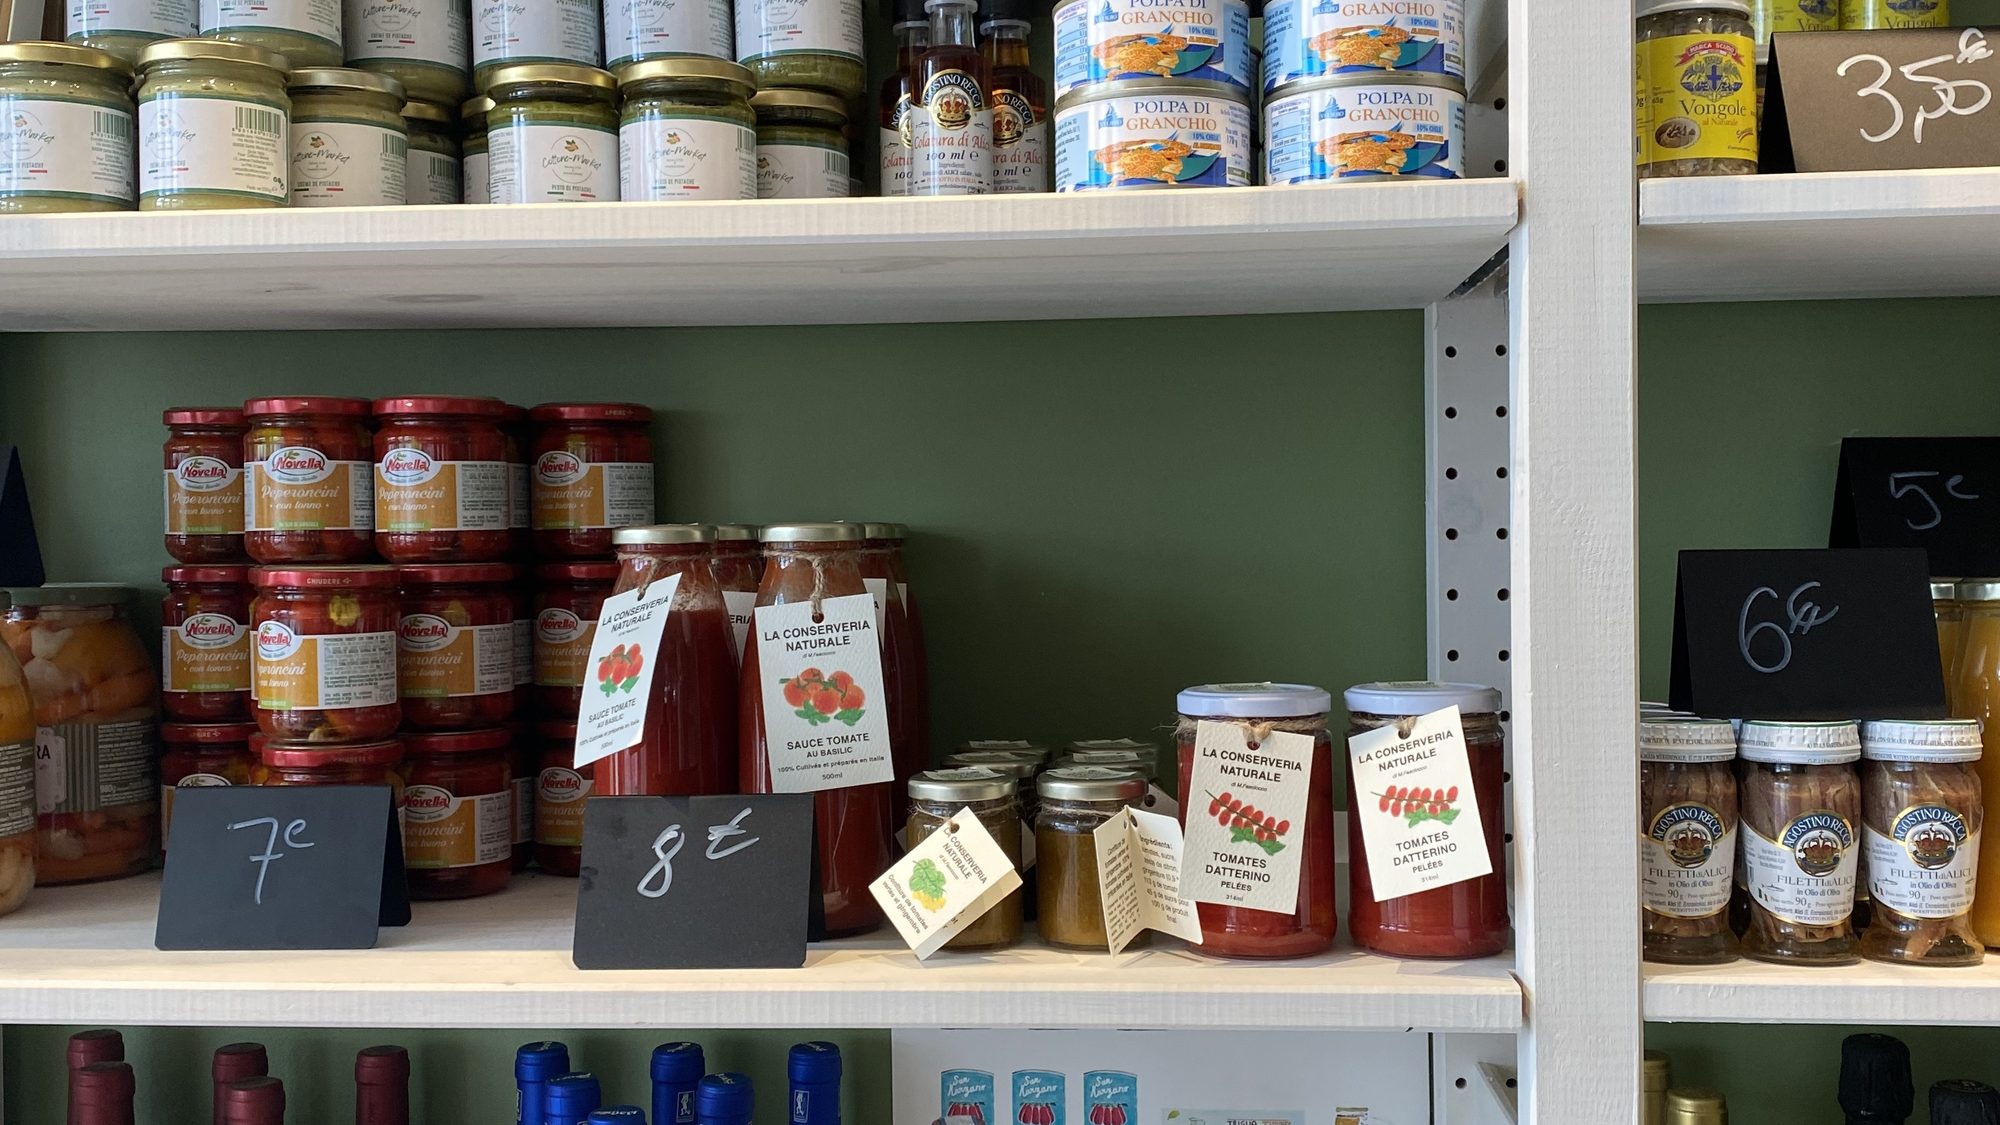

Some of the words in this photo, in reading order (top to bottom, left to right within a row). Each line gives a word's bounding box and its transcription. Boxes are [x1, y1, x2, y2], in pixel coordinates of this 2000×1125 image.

[1342, 2, 1435, 17] GRANCHIO
[1121, 10, 1213, 25] GRANCHIO
[923, 74, 960, 105] AGOSTINO
[960, 78, 981, 108] RECCA
[1358, 92, 1414, 105] POLPA
[1418, 93, 1433, 106] DI
[1010, 97, 1033, 124] RECCA
[1135, 101, 1190, 114] POLPA
[1194, 102, 1210, 114] DI
[1349, 108, 1440, 122] GRANCHIO
[1680, 99, 1747, 120] Vongole
[1126, 116, 1217, 131] GRANCHIO
[959, 131, 969, 147] di
[950, 150, 966, 160] ml
[272, 457, 325, 471] Novella
[384, 458, 430, 473] Novella
[539, 461, 579, 475] Novella
[180, 466, 227, 479] Novella
[261, 484, 340, 499] Peperoncini
[378, 487, 447, 502] Peperoncini
[294, 500, 323, 509] tonno
[601, 615, 612, 626] LA
[613, 595, 669, 622] CONSERVERIA
[539, 616, 578, 631] Novella
[610, 611, 653, 633] NATURALE
[186, 623, 235, 637] Novella
[400, 625, 448, 639] Novella
[763, 630, 780, 642] LA
[782, 620, 871, 639] CONSERVERIA
[259, 632, 291, 646] Novella
[785, 635, 851, 652] NATURALE
[176, 649, 249, 664] Peperoncini
[588, 708, 610, 723] SAUCE
[610, 698, 637, 714] TOMATE
[786, 738, 824, 750] SAUCE
[826, 733, 870, 746] TOMATE
[1358, 754, 1373, 765] LA
[1374, 729, 1454, 760] CONSERVERIA
[806, 750, 819, 758] AU
[820, 746, 853, 757] BASILIC
[1202, 748, 1218, 759] LA
[1220, 750, 1302, 772] CONSERVERIA
[1378, 748, 1438, 773] NATURALE
[1220, 765, 1282, 783] NATURALE
[542, 777, 580, 789] Novella
[401, 795, 450, 809] Novella
[1653, 808, 1698, 838] AGOSTINO
[1698, 810, 1723, 840] RECCA
[1894, 808, 1941, 840] AGOSTINO
[1942, 811, 1967, 841] RECCA
[1783, 815, 1830, 848] AGOSTINO
[1831, 818, 1852, 849] RECCA
[1395, 830, 1450, 853] TOMATES
[636, 824, 686, 898] 8
[942, 843, 973, 880] NATURALE
[950, 836, 989, 884] CONSERVERIA
[1212, 851, 1267, 869] TOMATES
[1392, 842, 1458, 867] DATTERINO
[1205, 865, 1271, 883] DATTERINO
[1412, 860, 1443, 874] PELÉES
[1649, 867, 1696, 878] FILETTI
[1704, 866, 1727, 878] ALICI
[1890, 868, 1939, 880] FILETTI
[1946, 867, 1972, 880] ALICI
[1220, 880, 1252, 892] PELÉES
[1777, 875, 1825, 886] FILETTI
[1831, 875, 1853, 886] ALICI
[1917, 881, 1933, 889] Olio
[1933, 881, 1941, 889] di
[1667, 889, 1679, 898] 90
[1908, 890, 1921, 899] 90
[1795, 897, 1807, 906] 90
[952, 1075, 971, 1086] San
[1023, 1075, 1042, 1086] San
[1095, 1076, 1114, 1087] San
[947, 1084, 987, 1097] Marzano
[1018, 1084, 1059, 1098] Marzano
[1089, 1085, 1130, 1099] Marzano
